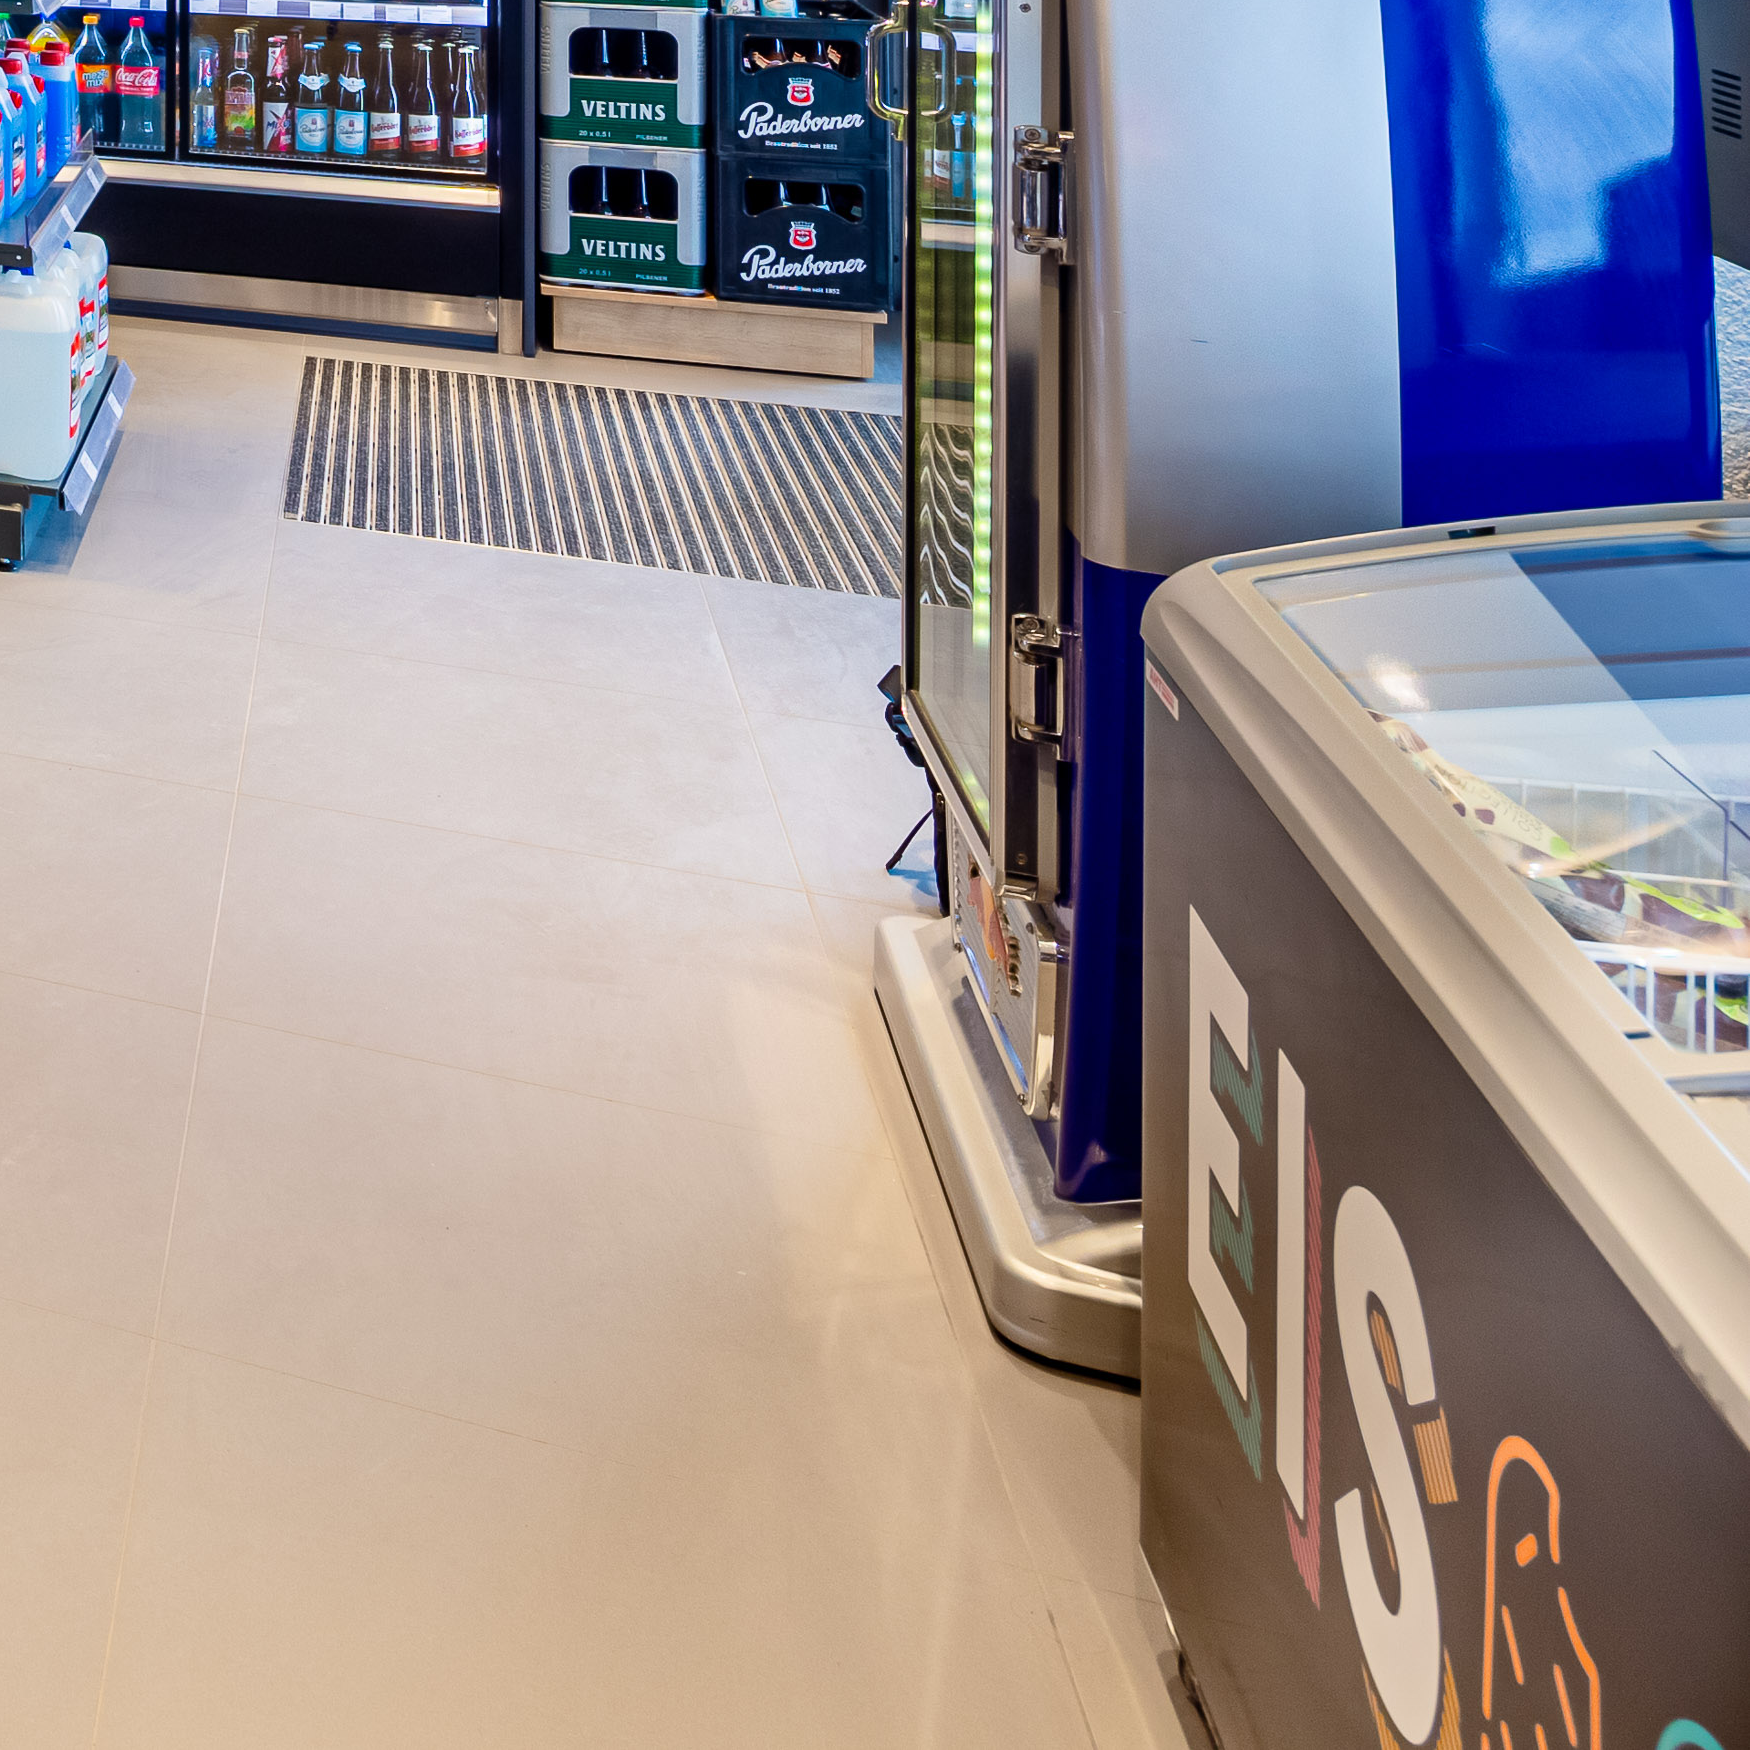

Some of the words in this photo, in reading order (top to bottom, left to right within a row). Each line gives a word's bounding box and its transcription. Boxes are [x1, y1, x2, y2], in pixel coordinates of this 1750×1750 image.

[581, 99, 666, 122] VELTINS
[737, 101, 864, 139] Paderborner
[581, 239, 666, 261] VELTINS
[740, 244, 867, 282] Paderborner
[1189, 904, 1442, 1746] EIS
